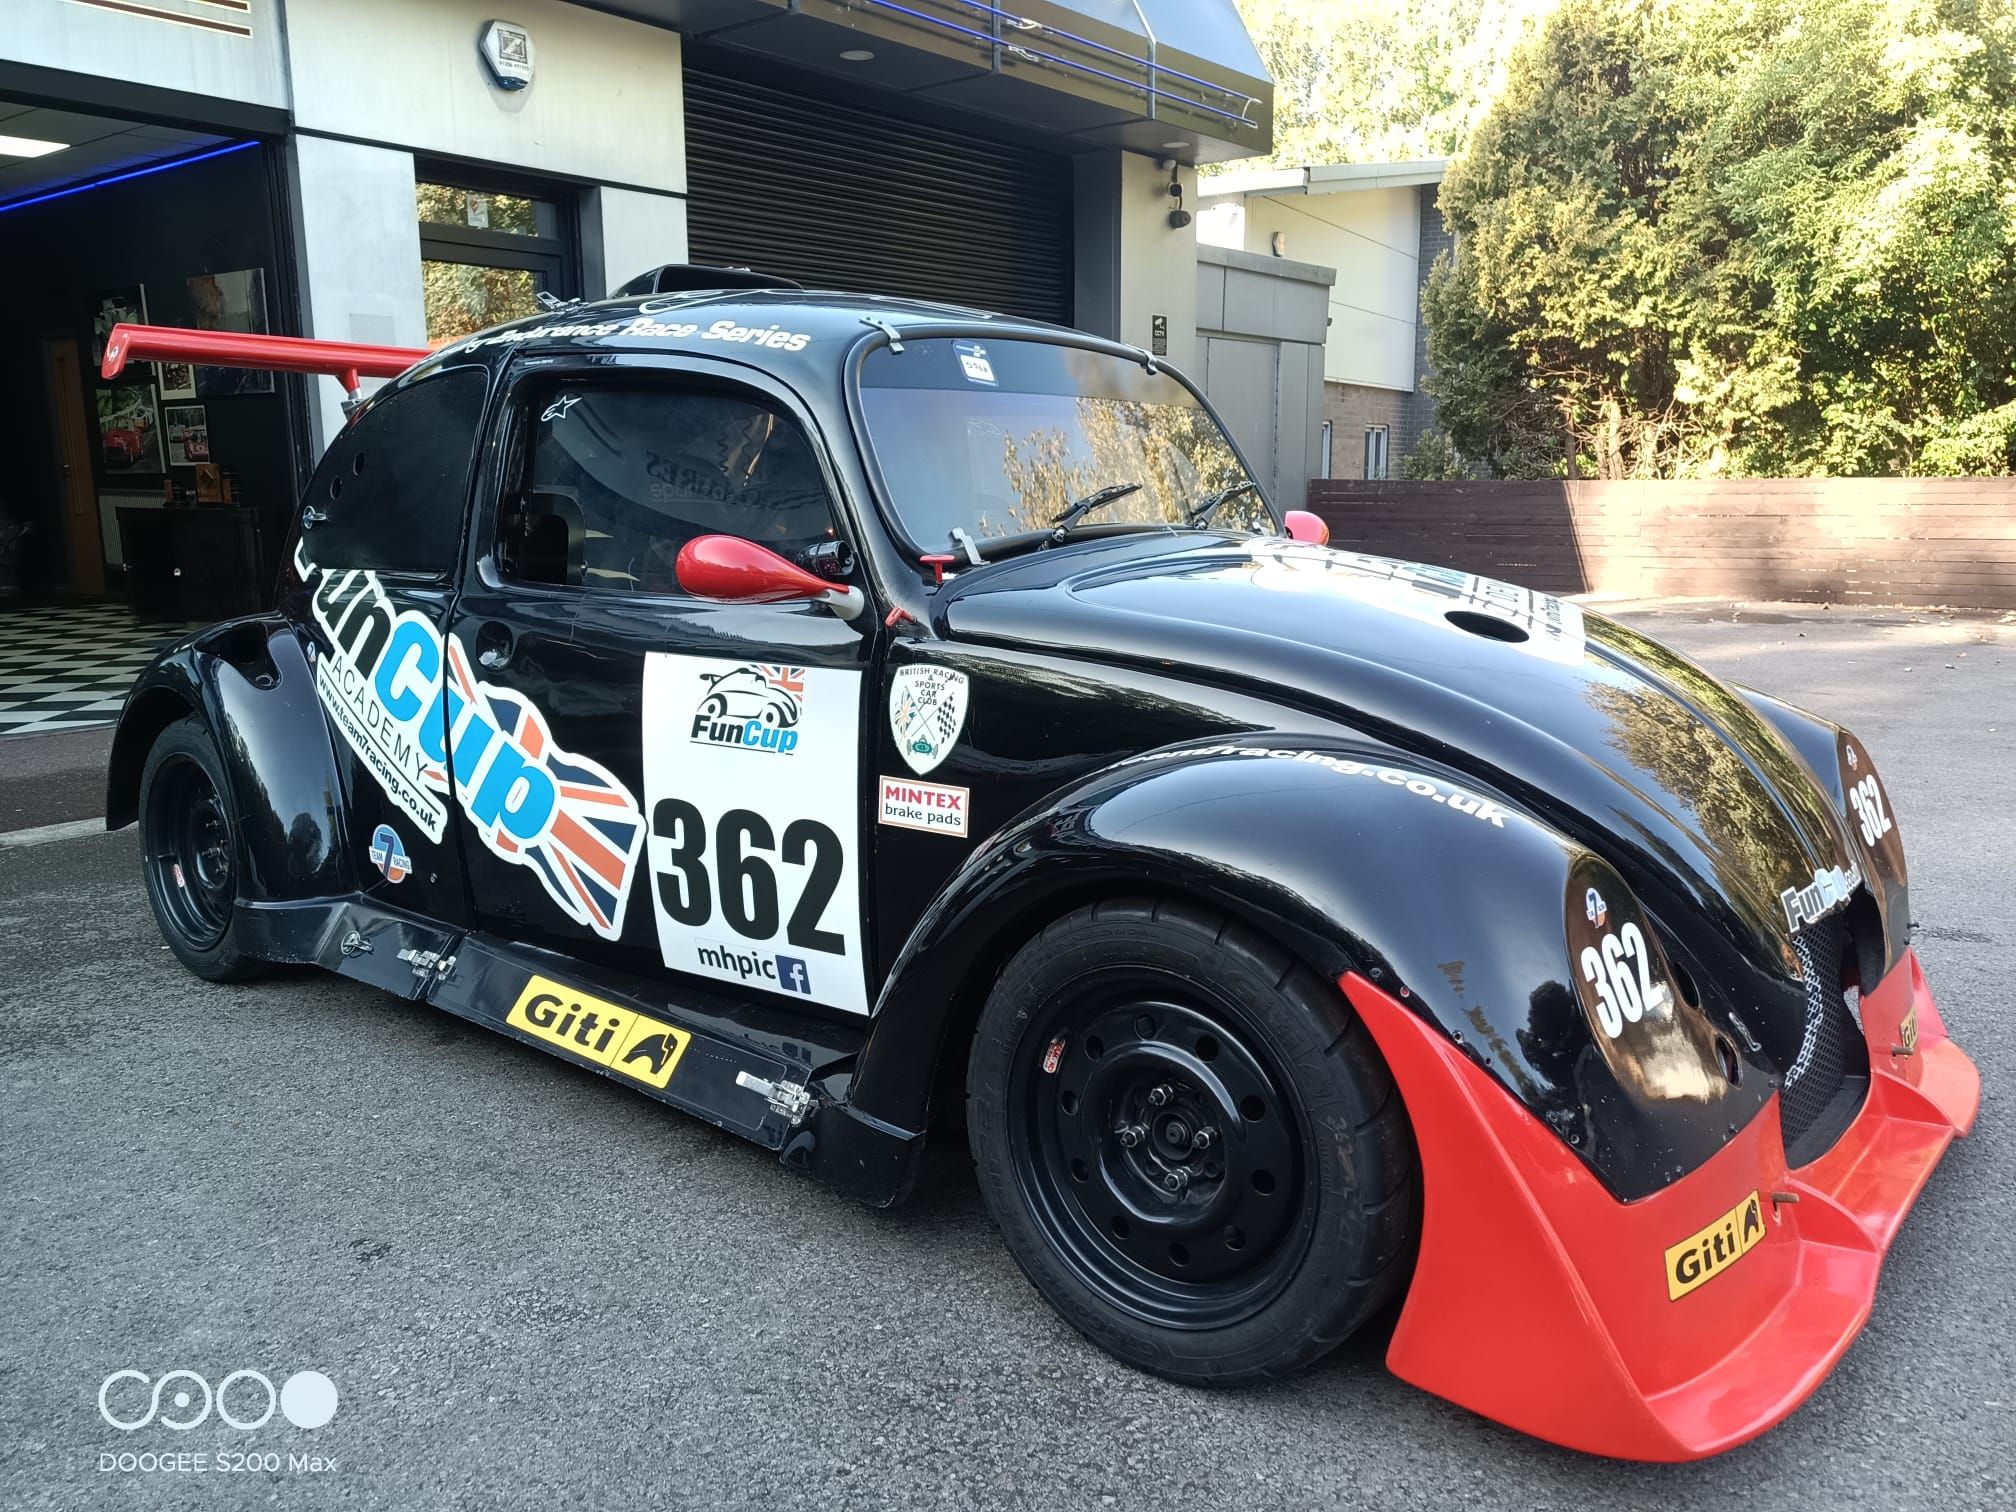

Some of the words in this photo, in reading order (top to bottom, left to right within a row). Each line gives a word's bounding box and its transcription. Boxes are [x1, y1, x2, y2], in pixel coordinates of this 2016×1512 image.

[619, 317, 698, 338] Race
[701, 319, 812, 351] Series
[296, 538, 555, 839] unCup
[899, 667, 930, 677] BRITISH
[933, 668, 965, 684] RACING
[914, 680, 945, 691] SPORTS
[920, 689, 937, 698] CAR
[332, 655, 428, 780] ACADEMY
[917, 696, 938, 706] CLUB
[319, 674, 438, 833] www.team7racing.co.uk
[690, 713, 799, 754] FunCup
[885, 784, 962, 811] MINTEX
[885, 802, 923, 820] brake
[927, 810, 961, 827] pads
[1849, 774, 1892, 847] 362
[379, 832, 395, 878] 7
[653, 798, 846, 956] 362
[697, 945, 777, 979] mhpic
[1580, 921, 1665, 1039] 362
[524, 993, 621, 1053] Giti
[1675, 1221, 1736, 1285] Giti
